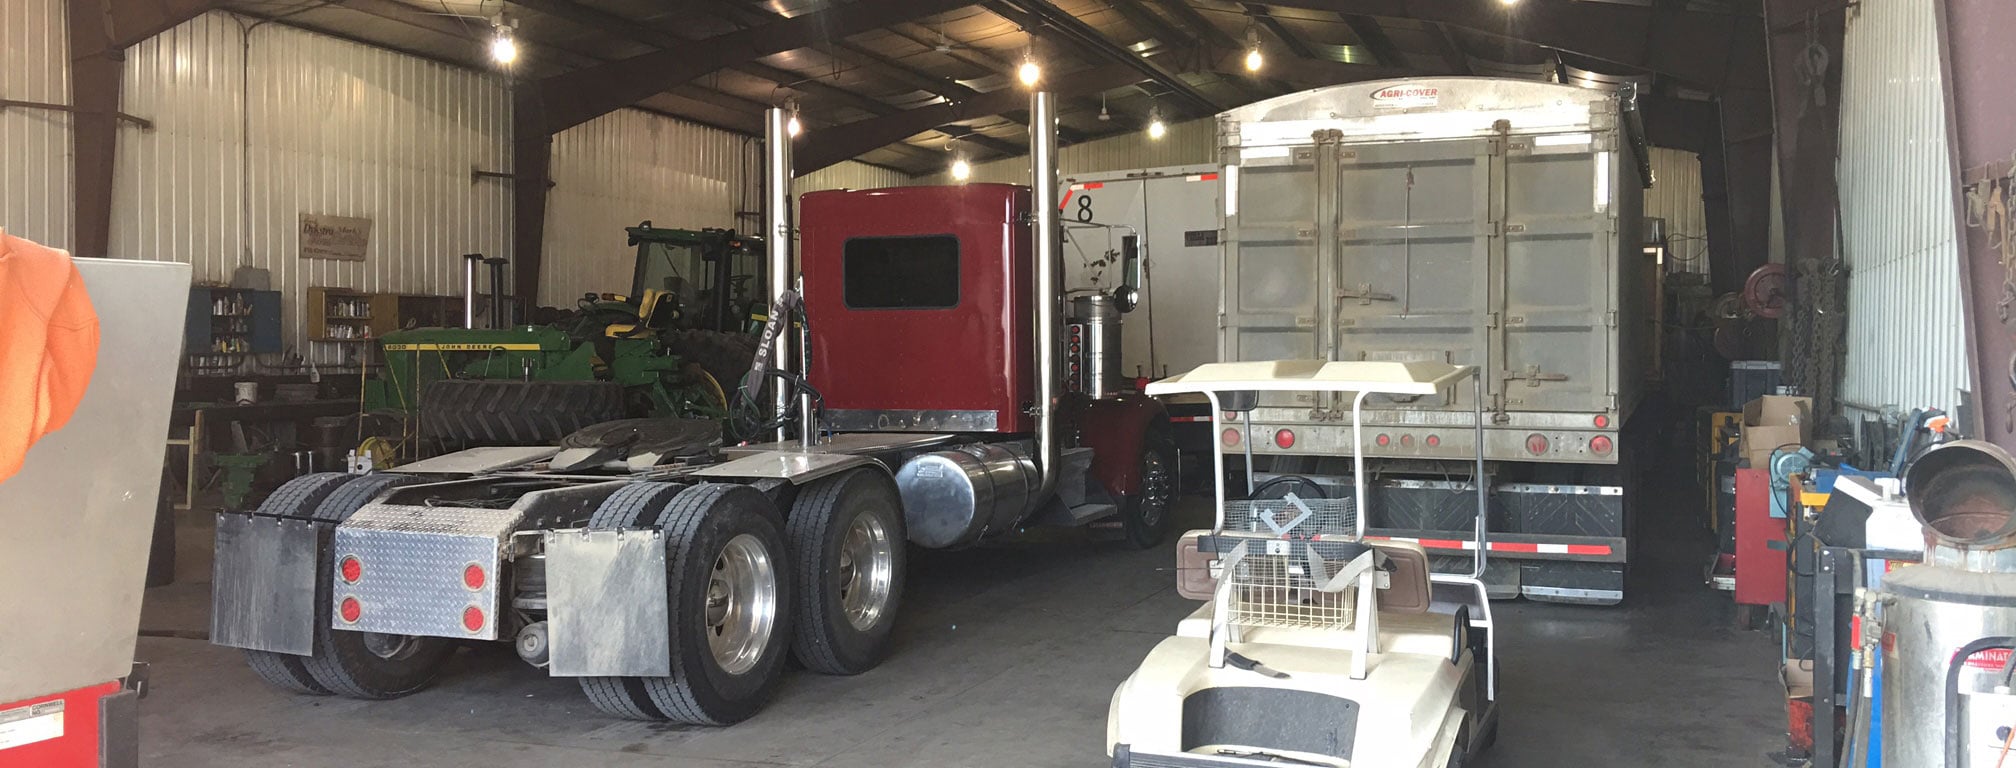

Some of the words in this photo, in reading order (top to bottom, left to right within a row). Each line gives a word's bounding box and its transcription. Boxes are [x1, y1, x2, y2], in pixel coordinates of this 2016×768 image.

[1380, 88, 1438, 98] AGRI-COVER
[1077, 195, 1093, 222] 8
[758, 310, 779, 357] SLOAN
